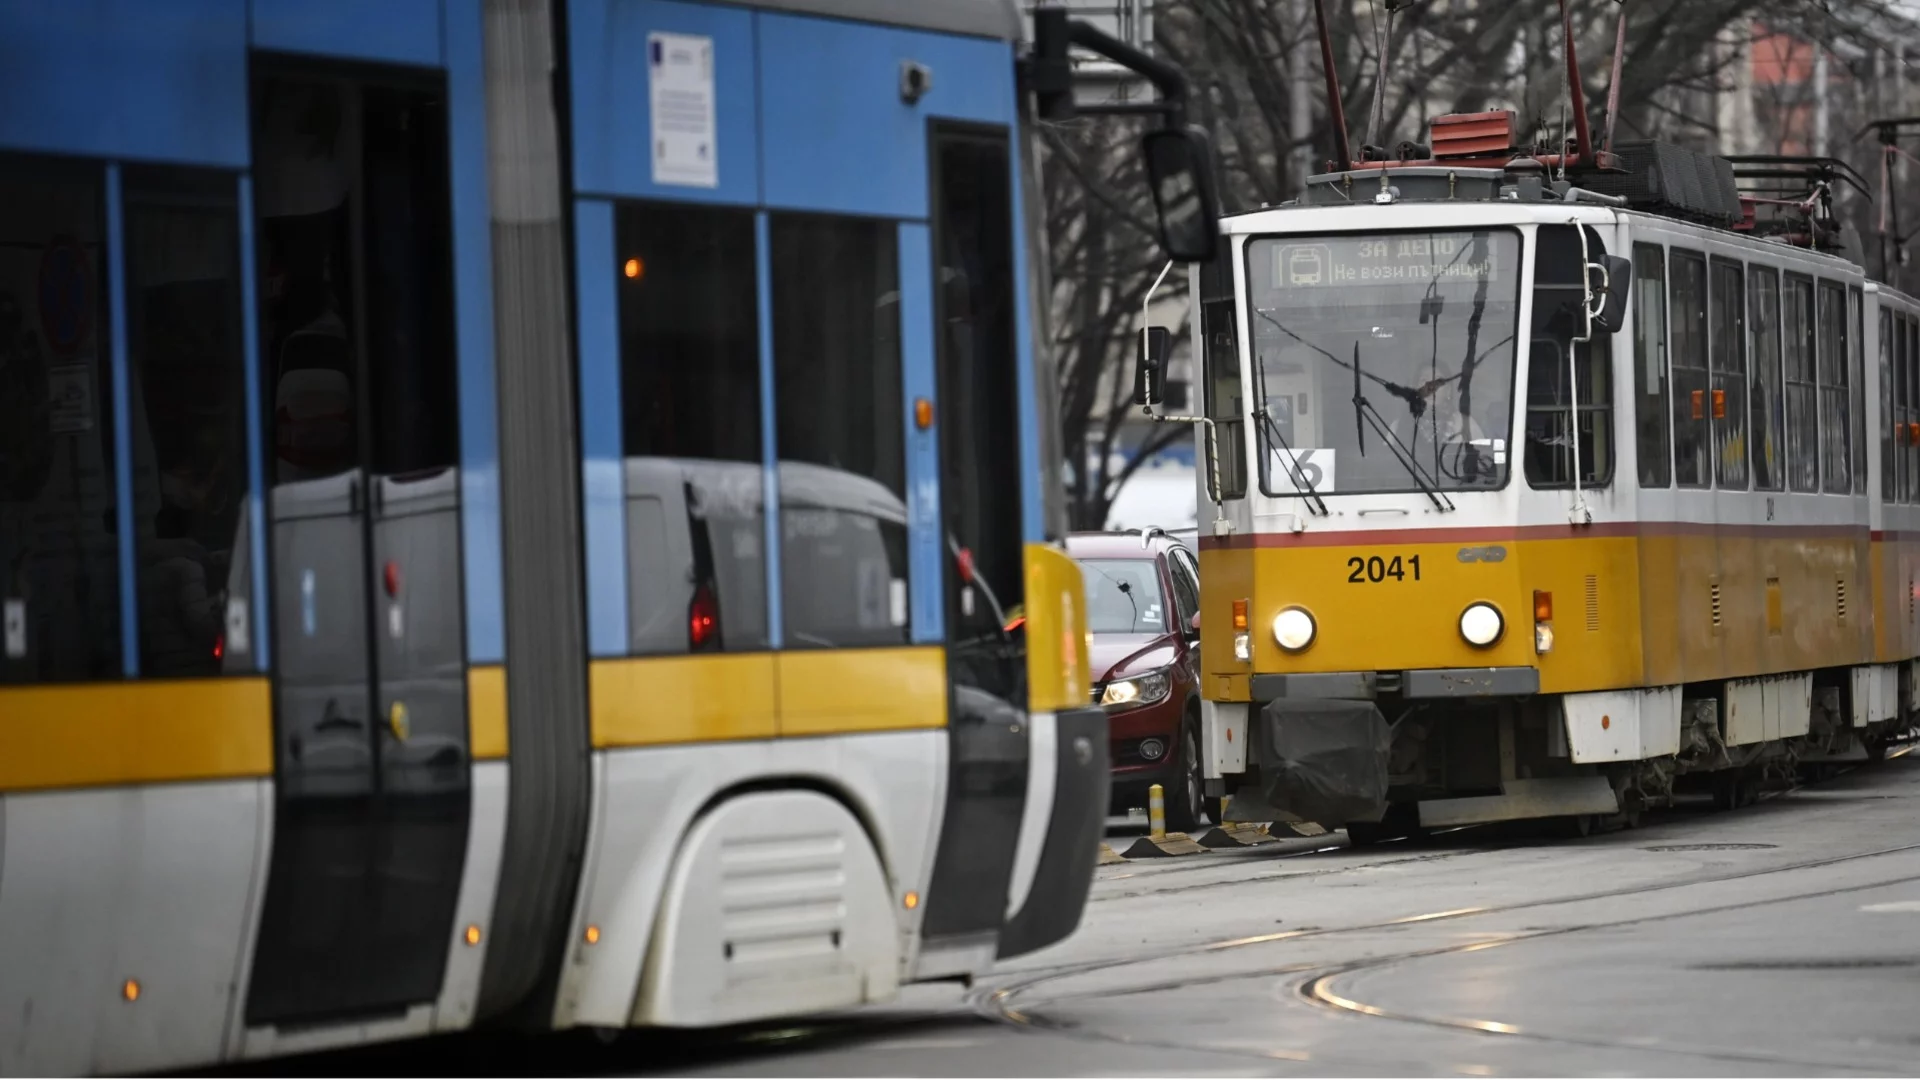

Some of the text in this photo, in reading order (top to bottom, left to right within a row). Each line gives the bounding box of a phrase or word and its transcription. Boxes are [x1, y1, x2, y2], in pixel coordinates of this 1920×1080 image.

[1358, 238, 1455, 258] ЗА ДЕПО
[1335, 263, 1356, 280] Не
[1361, 265, 1404, 280] вози
[1290, 450, 1323, 489] 6
[1347, 554, 1420, 583] 2041
